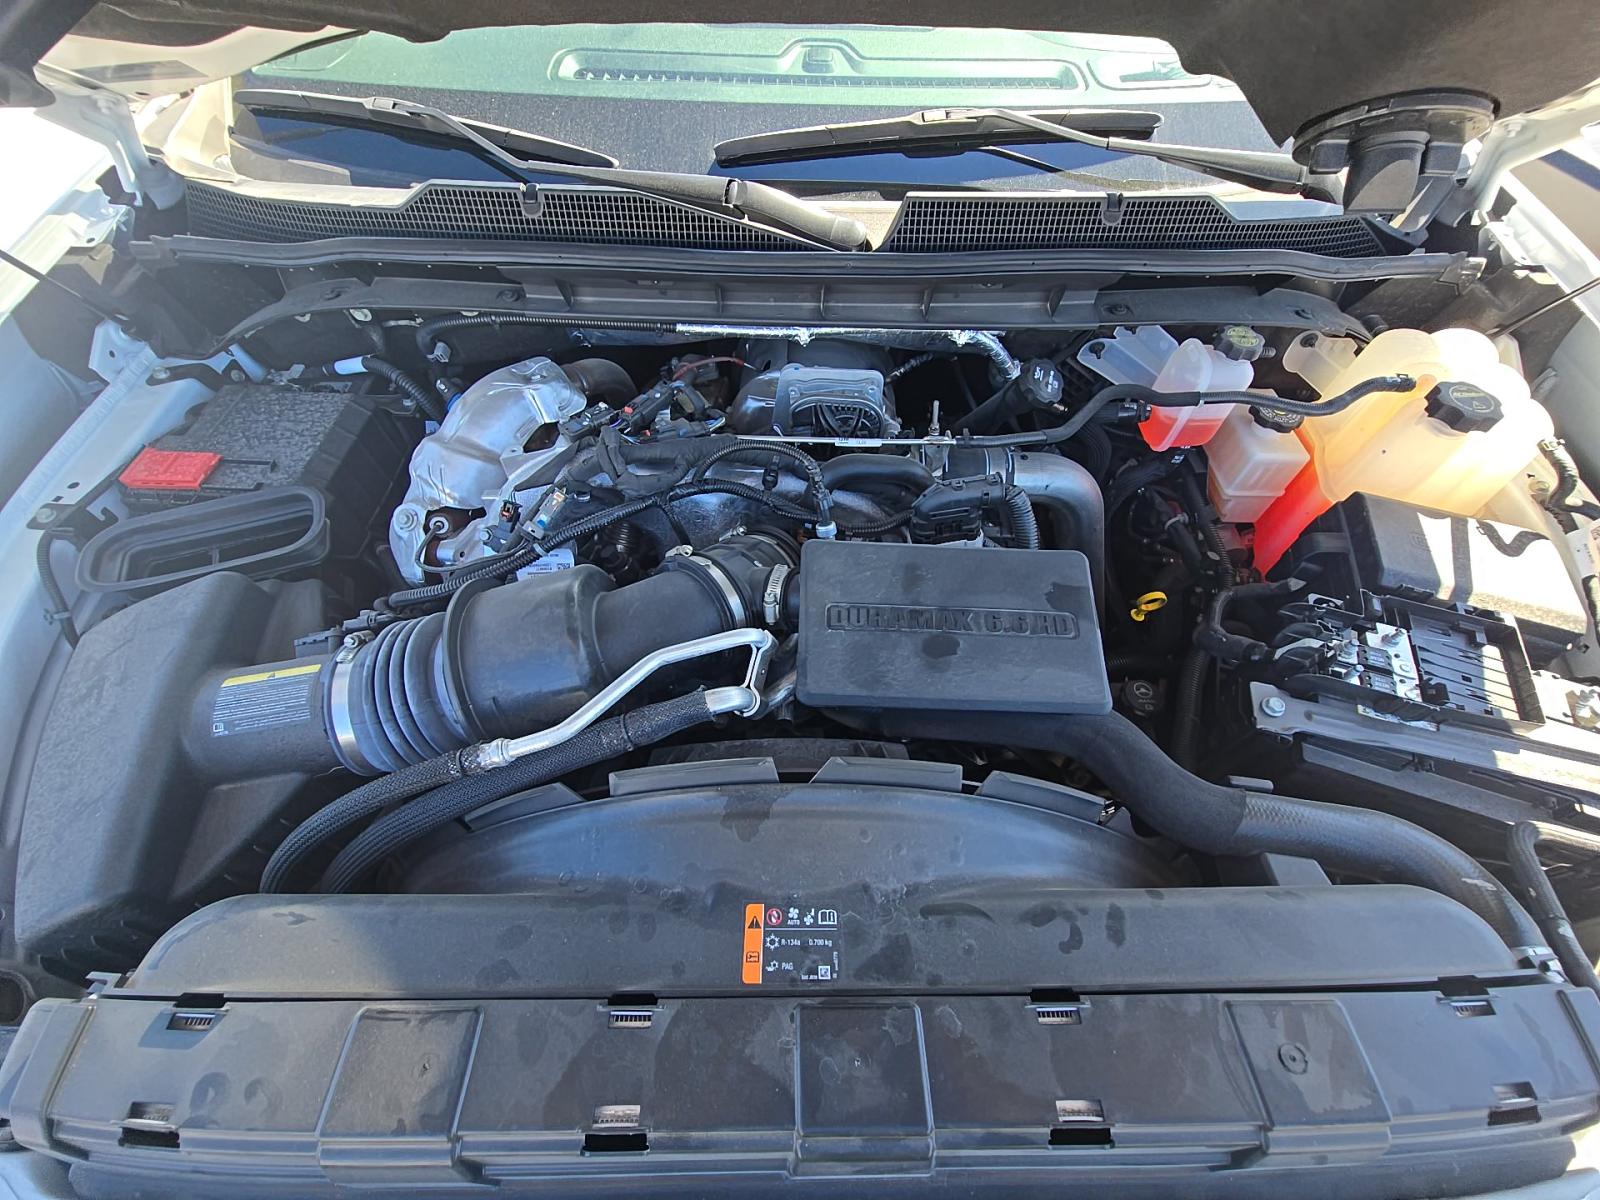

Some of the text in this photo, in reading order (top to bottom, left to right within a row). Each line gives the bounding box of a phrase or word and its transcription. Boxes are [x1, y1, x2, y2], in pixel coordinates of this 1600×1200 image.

[829, 606, 976, 632] DURAMAX
[825, 939, 832, 947] kg
[781, 962, 794, 970] PAG
